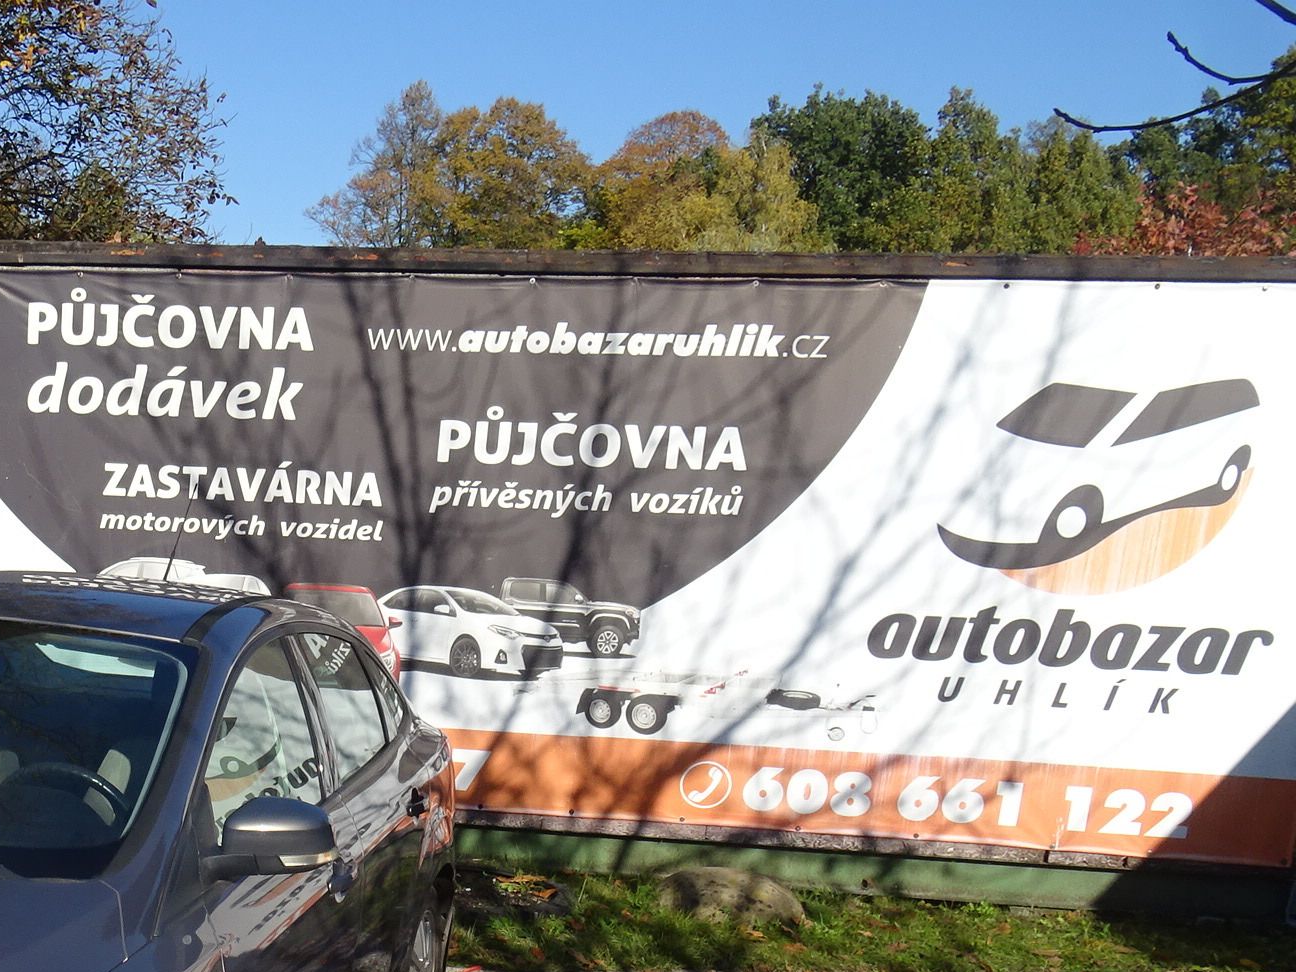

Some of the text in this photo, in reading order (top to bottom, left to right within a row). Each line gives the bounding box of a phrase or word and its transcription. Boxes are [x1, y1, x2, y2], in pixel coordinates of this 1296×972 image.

[27, 288, 314, 352] PŮJČOVNA
[367, 321, 830, 360] www.autobazaruhlik.cz
[27, 362, 305, 422] dodávek
[436, 405, 747, 472] PŮJČOVNA
[102, 460, 383, 508] ZASTAVÁRNA
[429, 479, 744, 519] přívěsných vozíků
[99, 511, 385, 543] motorových vozidel
[867, 605, 1275, 676] autobazar
[937, 676, 1179, 715] UHLÍK
[742, 766, 1194, 840] 608 661 122
